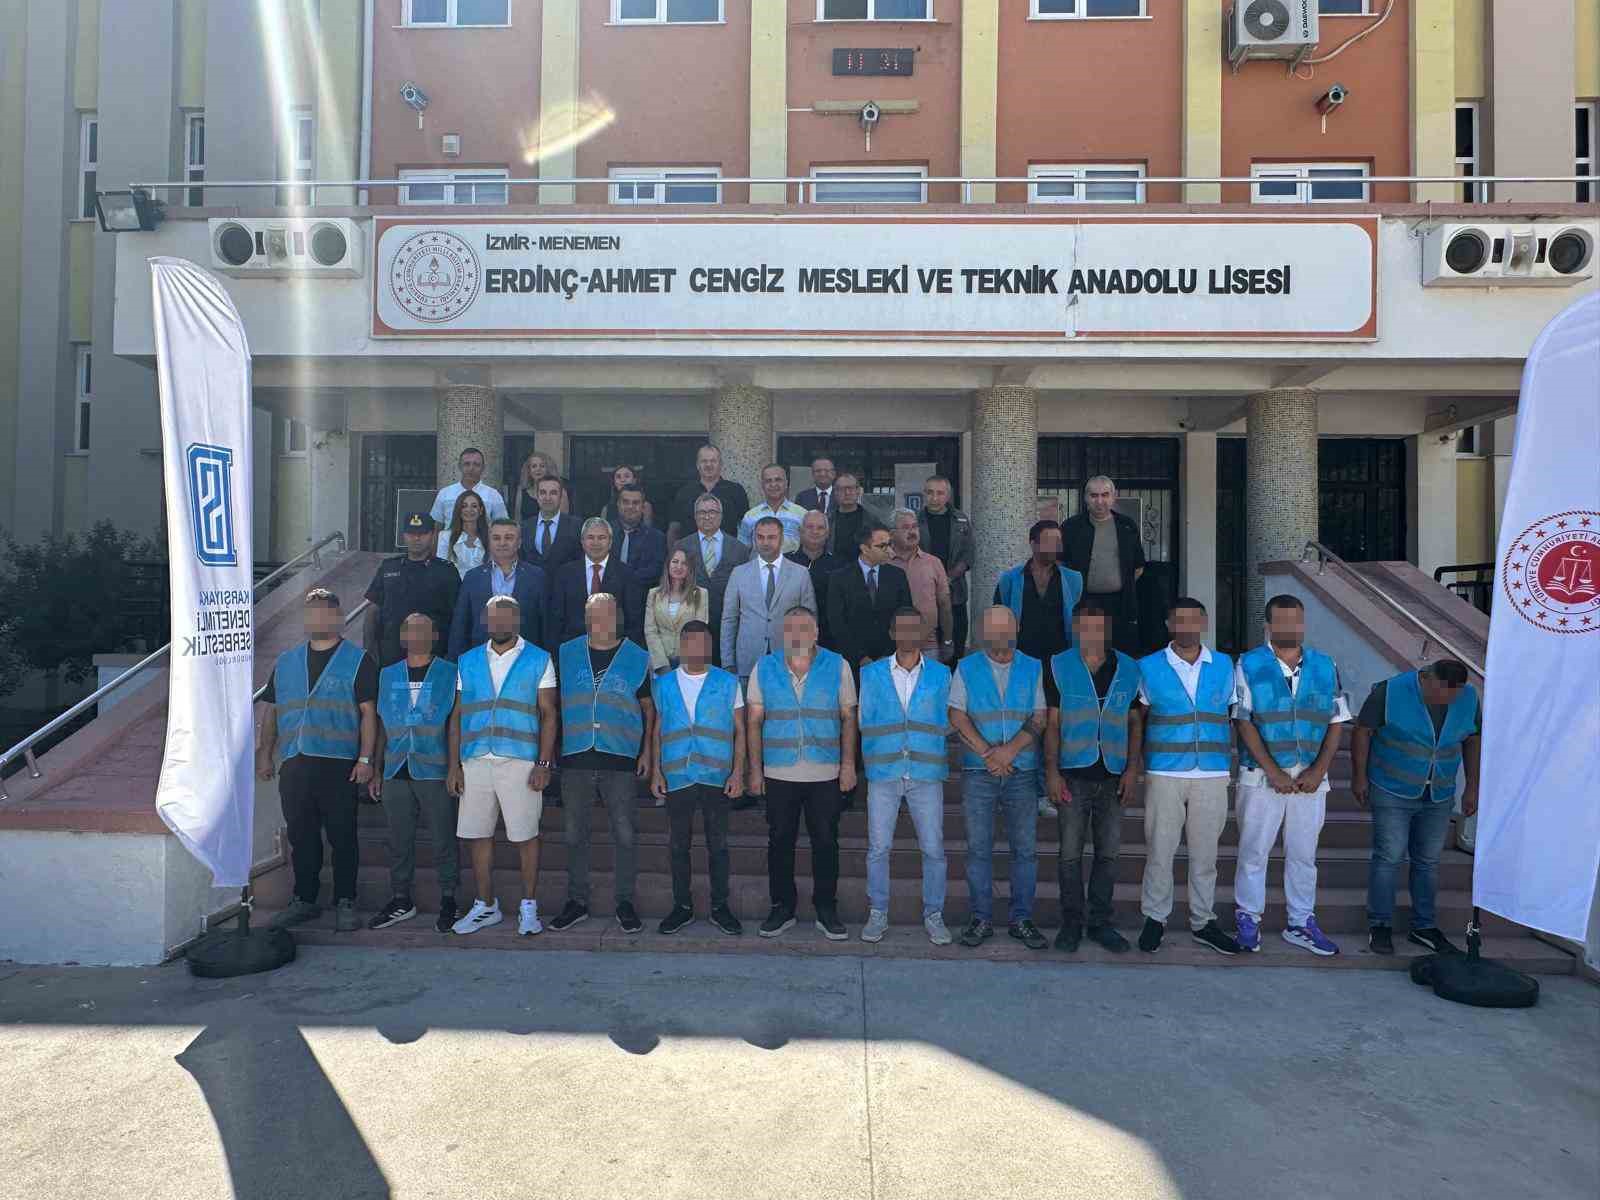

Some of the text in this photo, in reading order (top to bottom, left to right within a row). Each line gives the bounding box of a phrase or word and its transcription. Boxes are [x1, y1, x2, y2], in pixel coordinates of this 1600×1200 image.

[485, 264, 1291, 300] ERDİNÇ-AHMET CENGİZ MESLEKİ VE TEKNİK ANADOLU LİSESİ
